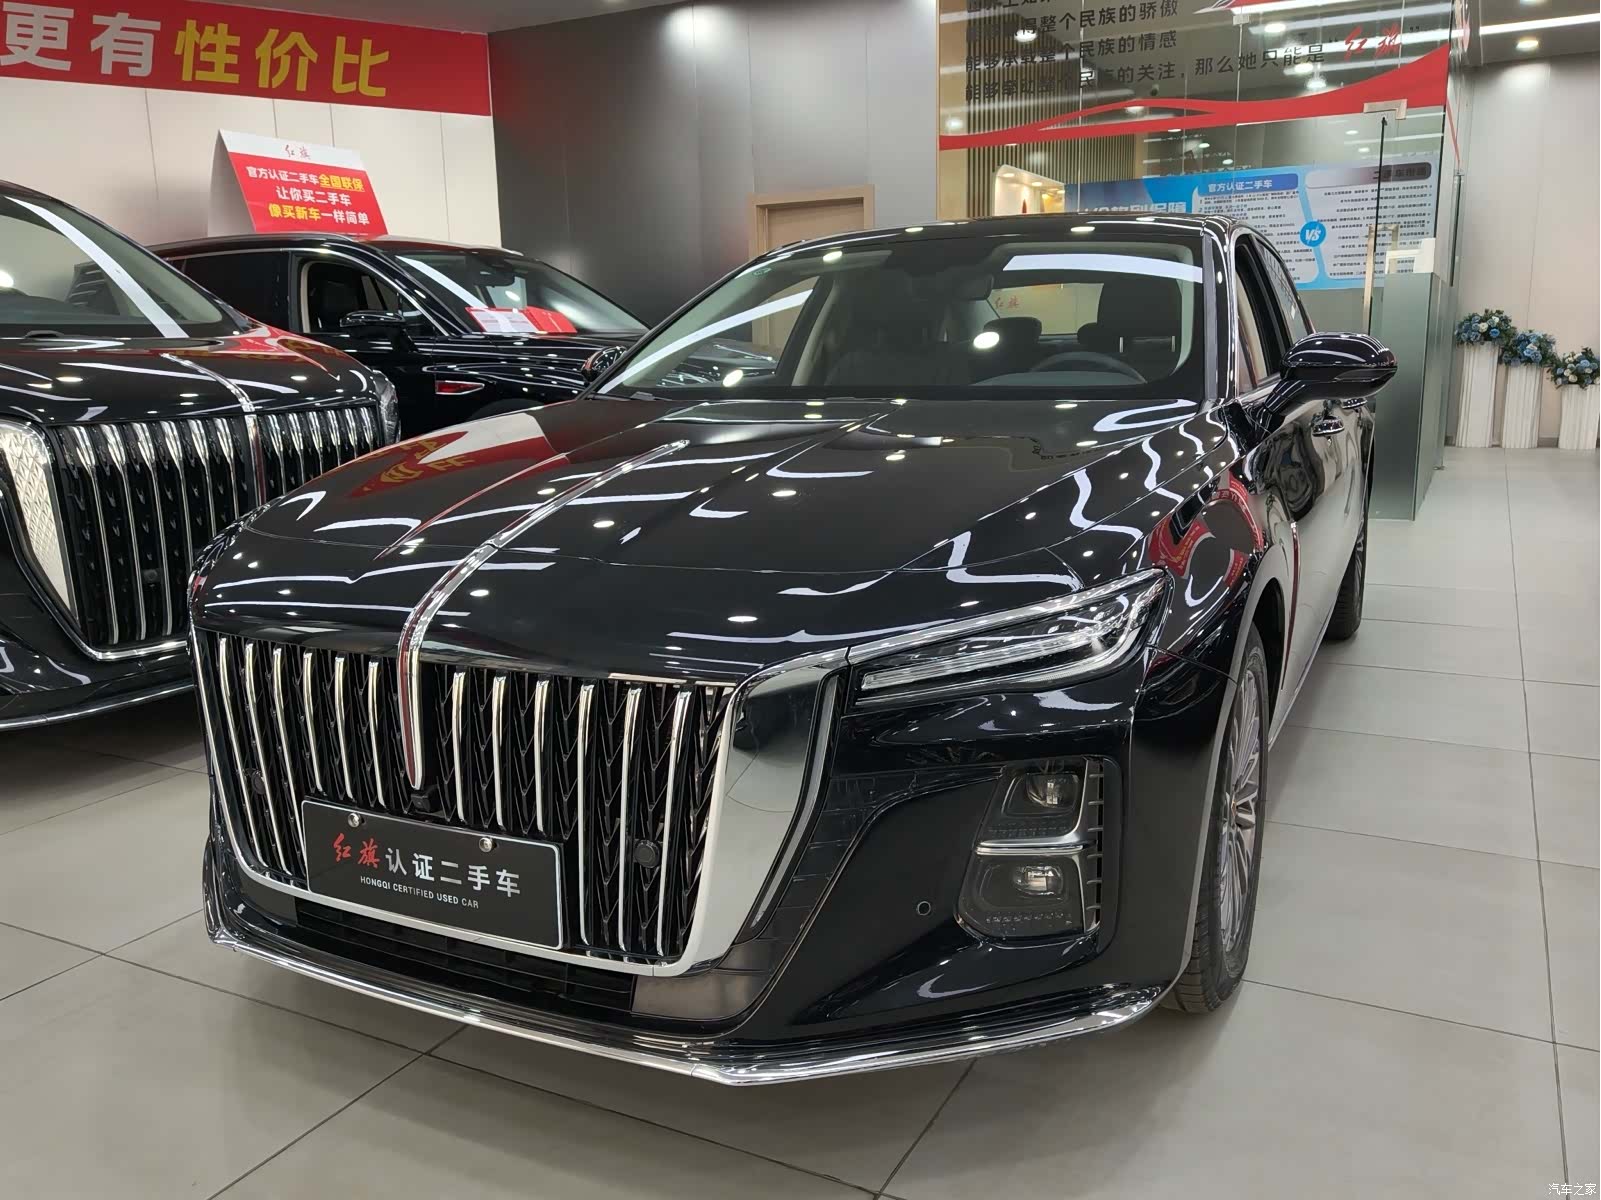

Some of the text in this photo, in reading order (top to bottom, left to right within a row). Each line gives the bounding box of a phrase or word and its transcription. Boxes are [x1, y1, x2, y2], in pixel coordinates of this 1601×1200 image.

[0, 1, 390, 97] 更有性价比
[285, 144, 311, 160] 红旗
[246, 166, 364, 191] 官方认证二手车全国联保
[1208, 178, 1273, 193] 官方认证二手车
[276, 186, 352, 206] 让你买二手车
[268, 203, 370, 225] 像买新车一样简单
[1305, 229, 1322, 243] VS
[332, 833, 521, 898] 红旗认证二手车
[360, 875, 479, 909] HONGQI CERTIFIED USED CAR
